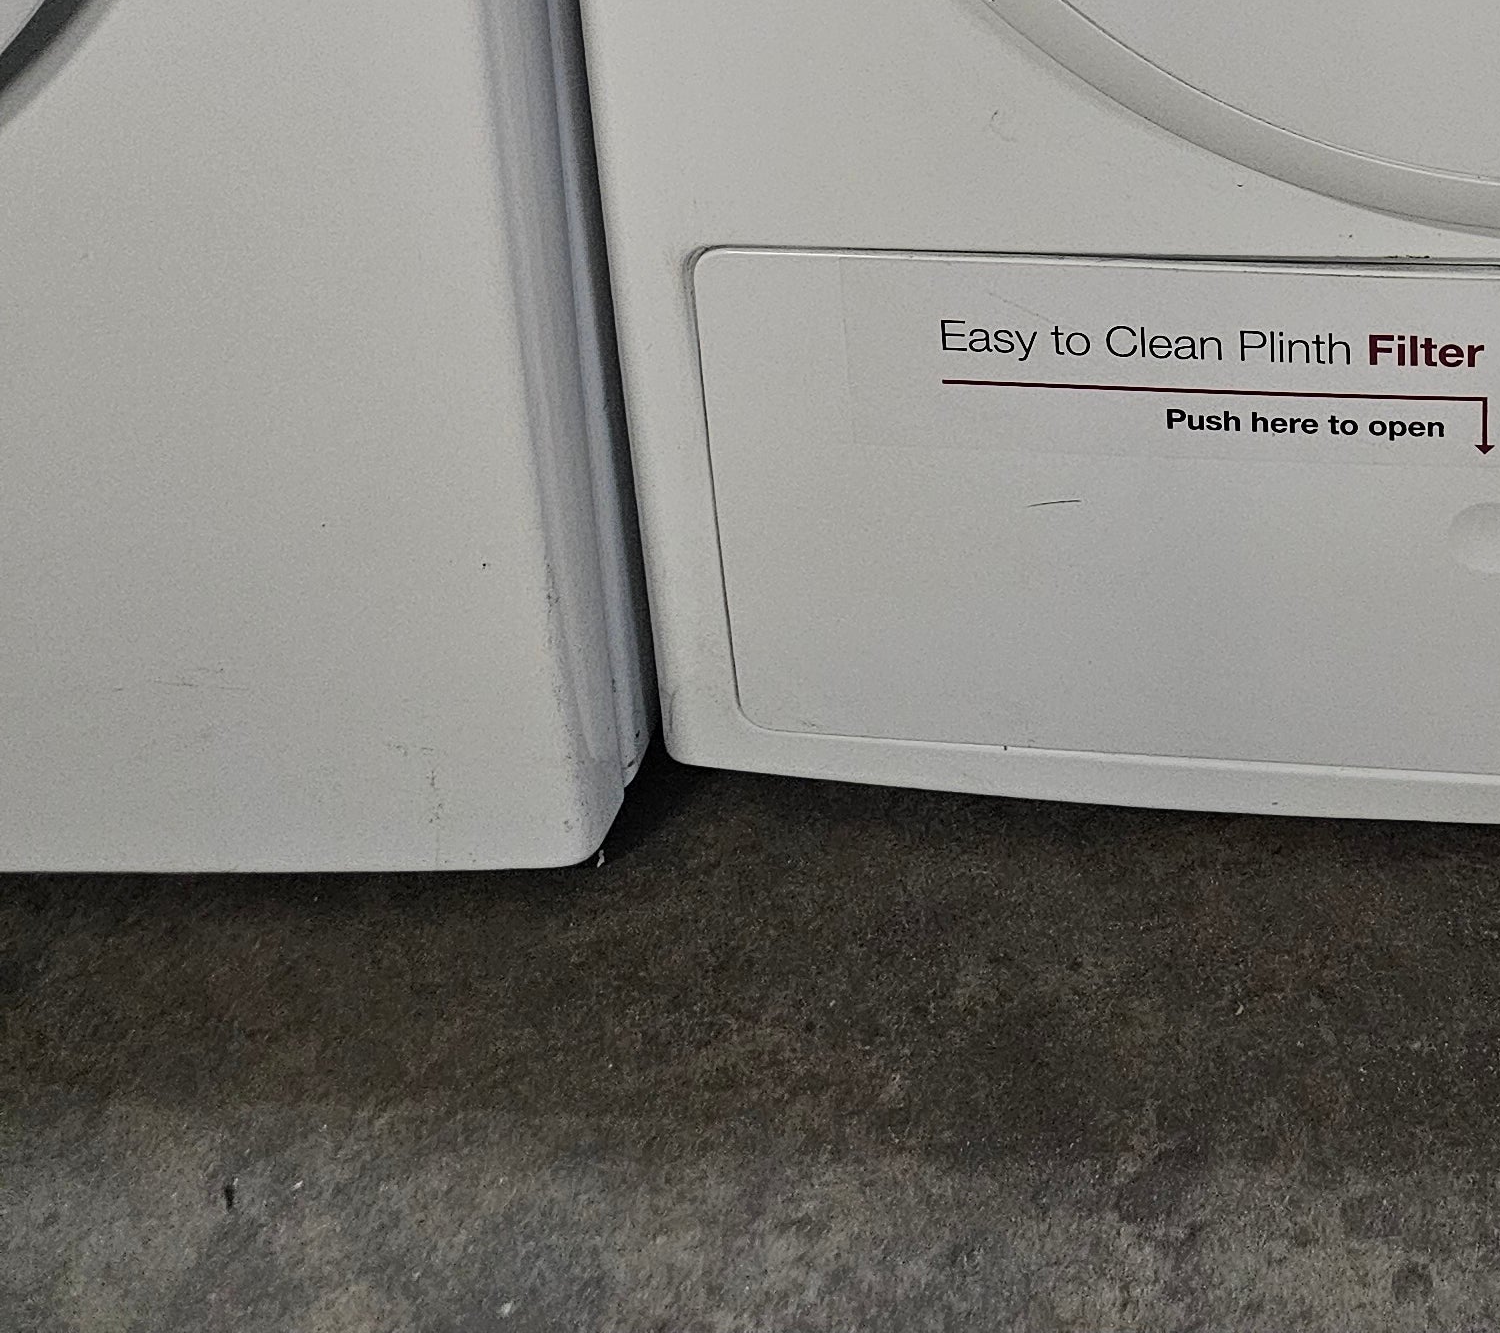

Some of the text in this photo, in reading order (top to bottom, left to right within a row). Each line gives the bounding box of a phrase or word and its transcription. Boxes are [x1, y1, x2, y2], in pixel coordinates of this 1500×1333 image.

[940, 319, 1485, 368] Easy to Clean Plinth Filter
[1166, 408, 1445, 442] Push here to open
